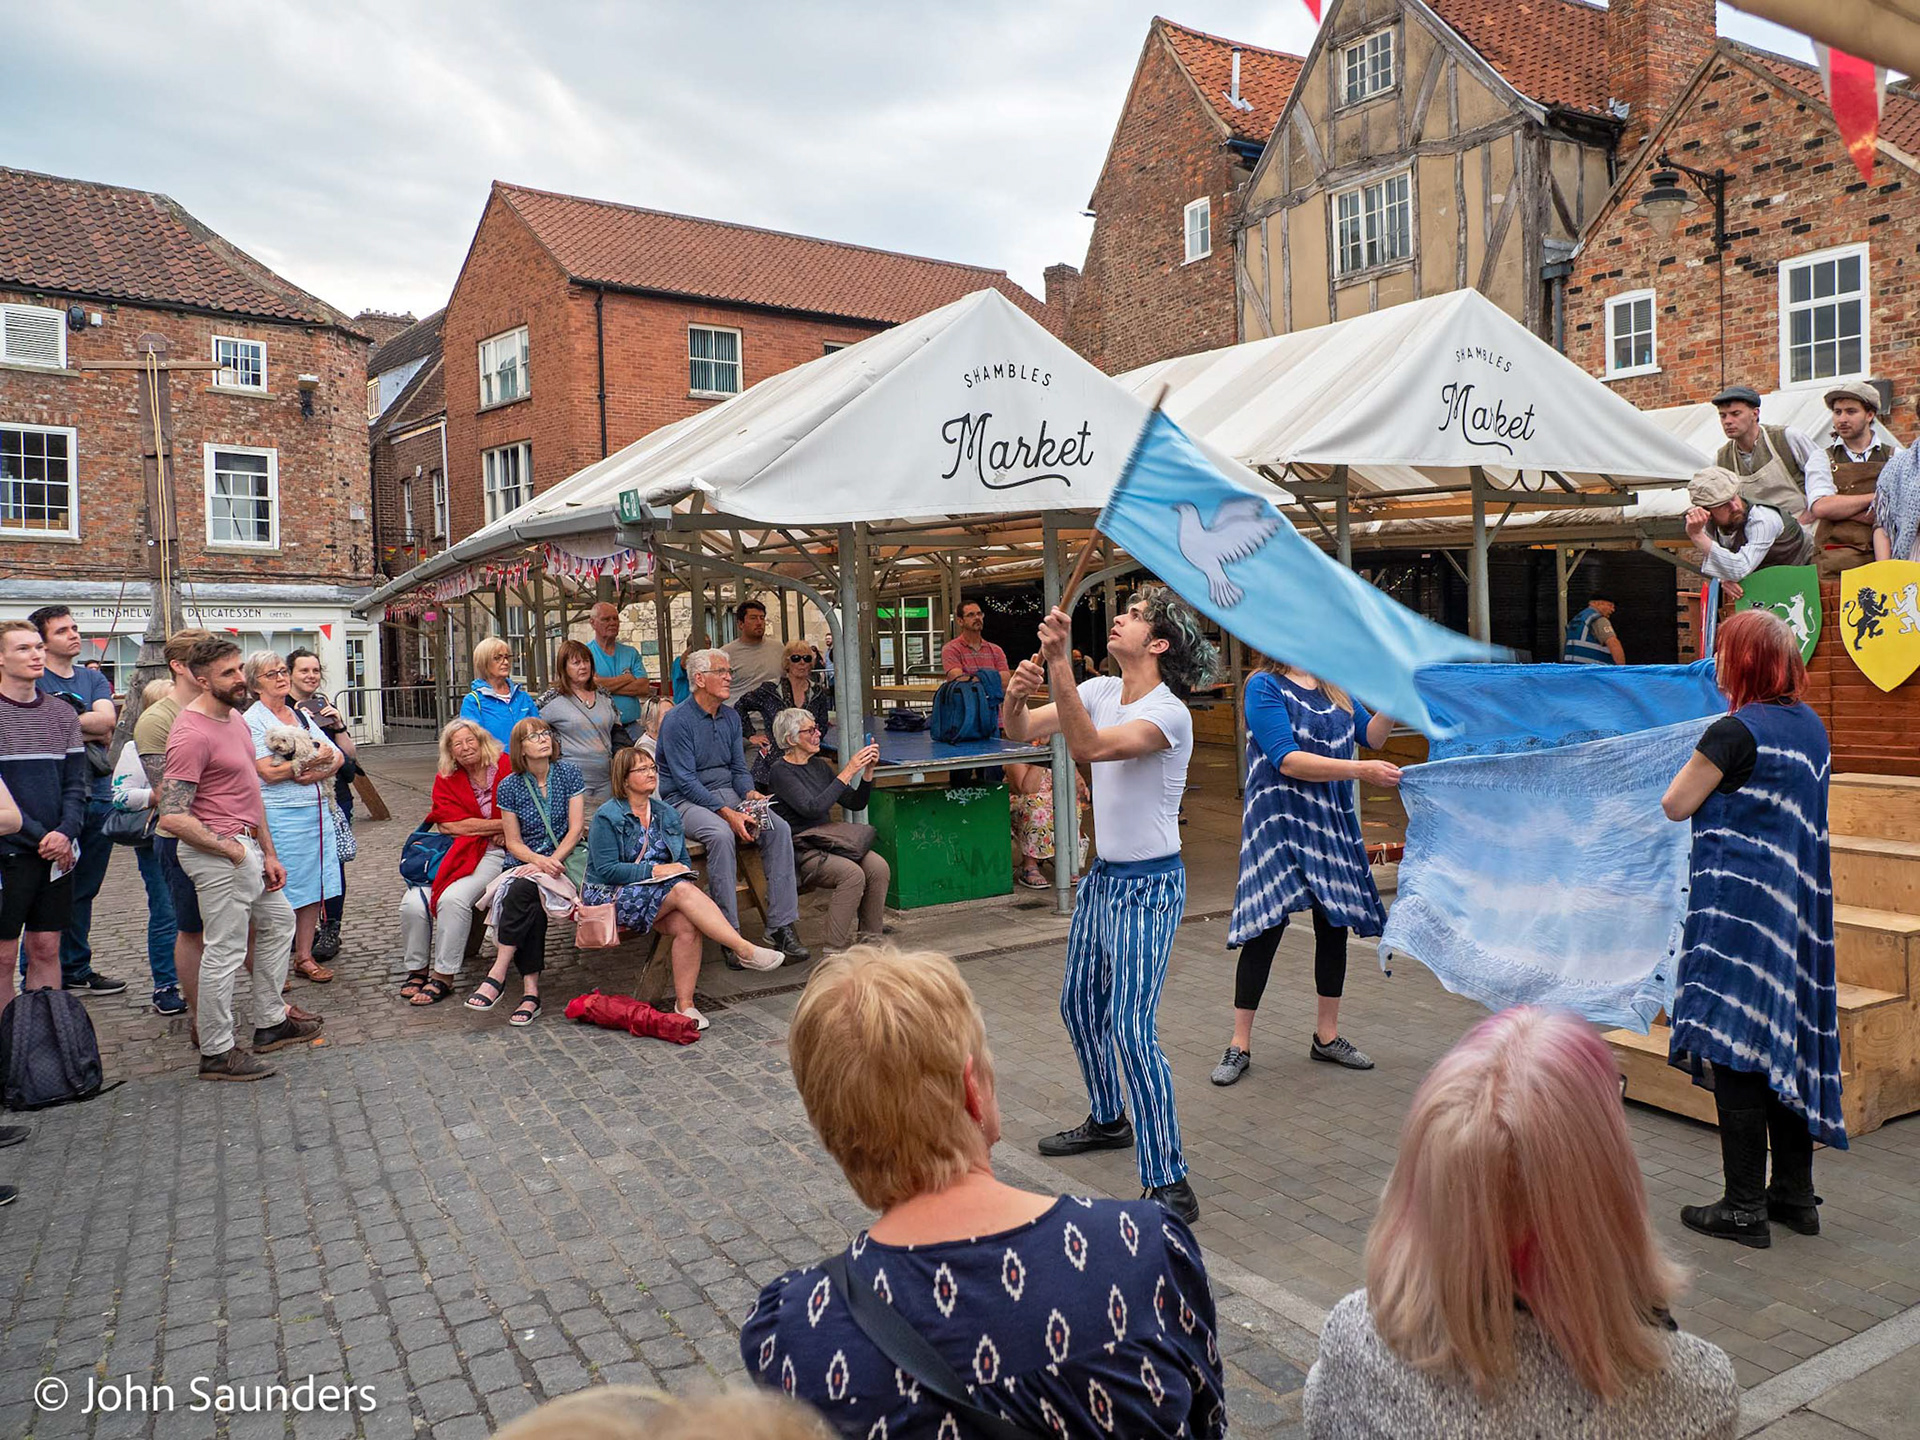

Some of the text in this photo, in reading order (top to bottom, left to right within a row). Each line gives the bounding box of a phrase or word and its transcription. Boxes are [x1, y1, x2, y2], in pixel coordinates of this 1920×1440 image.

[1455, 347, 1513, 373] SHAMBLES
[963, 363, 1052, 388] SHAMBLES
[941, 412, 1094, 490] Market
[93, 607, 152, 618] HENSHELW
[187, 608, 262, 618] DELICATESSEN
